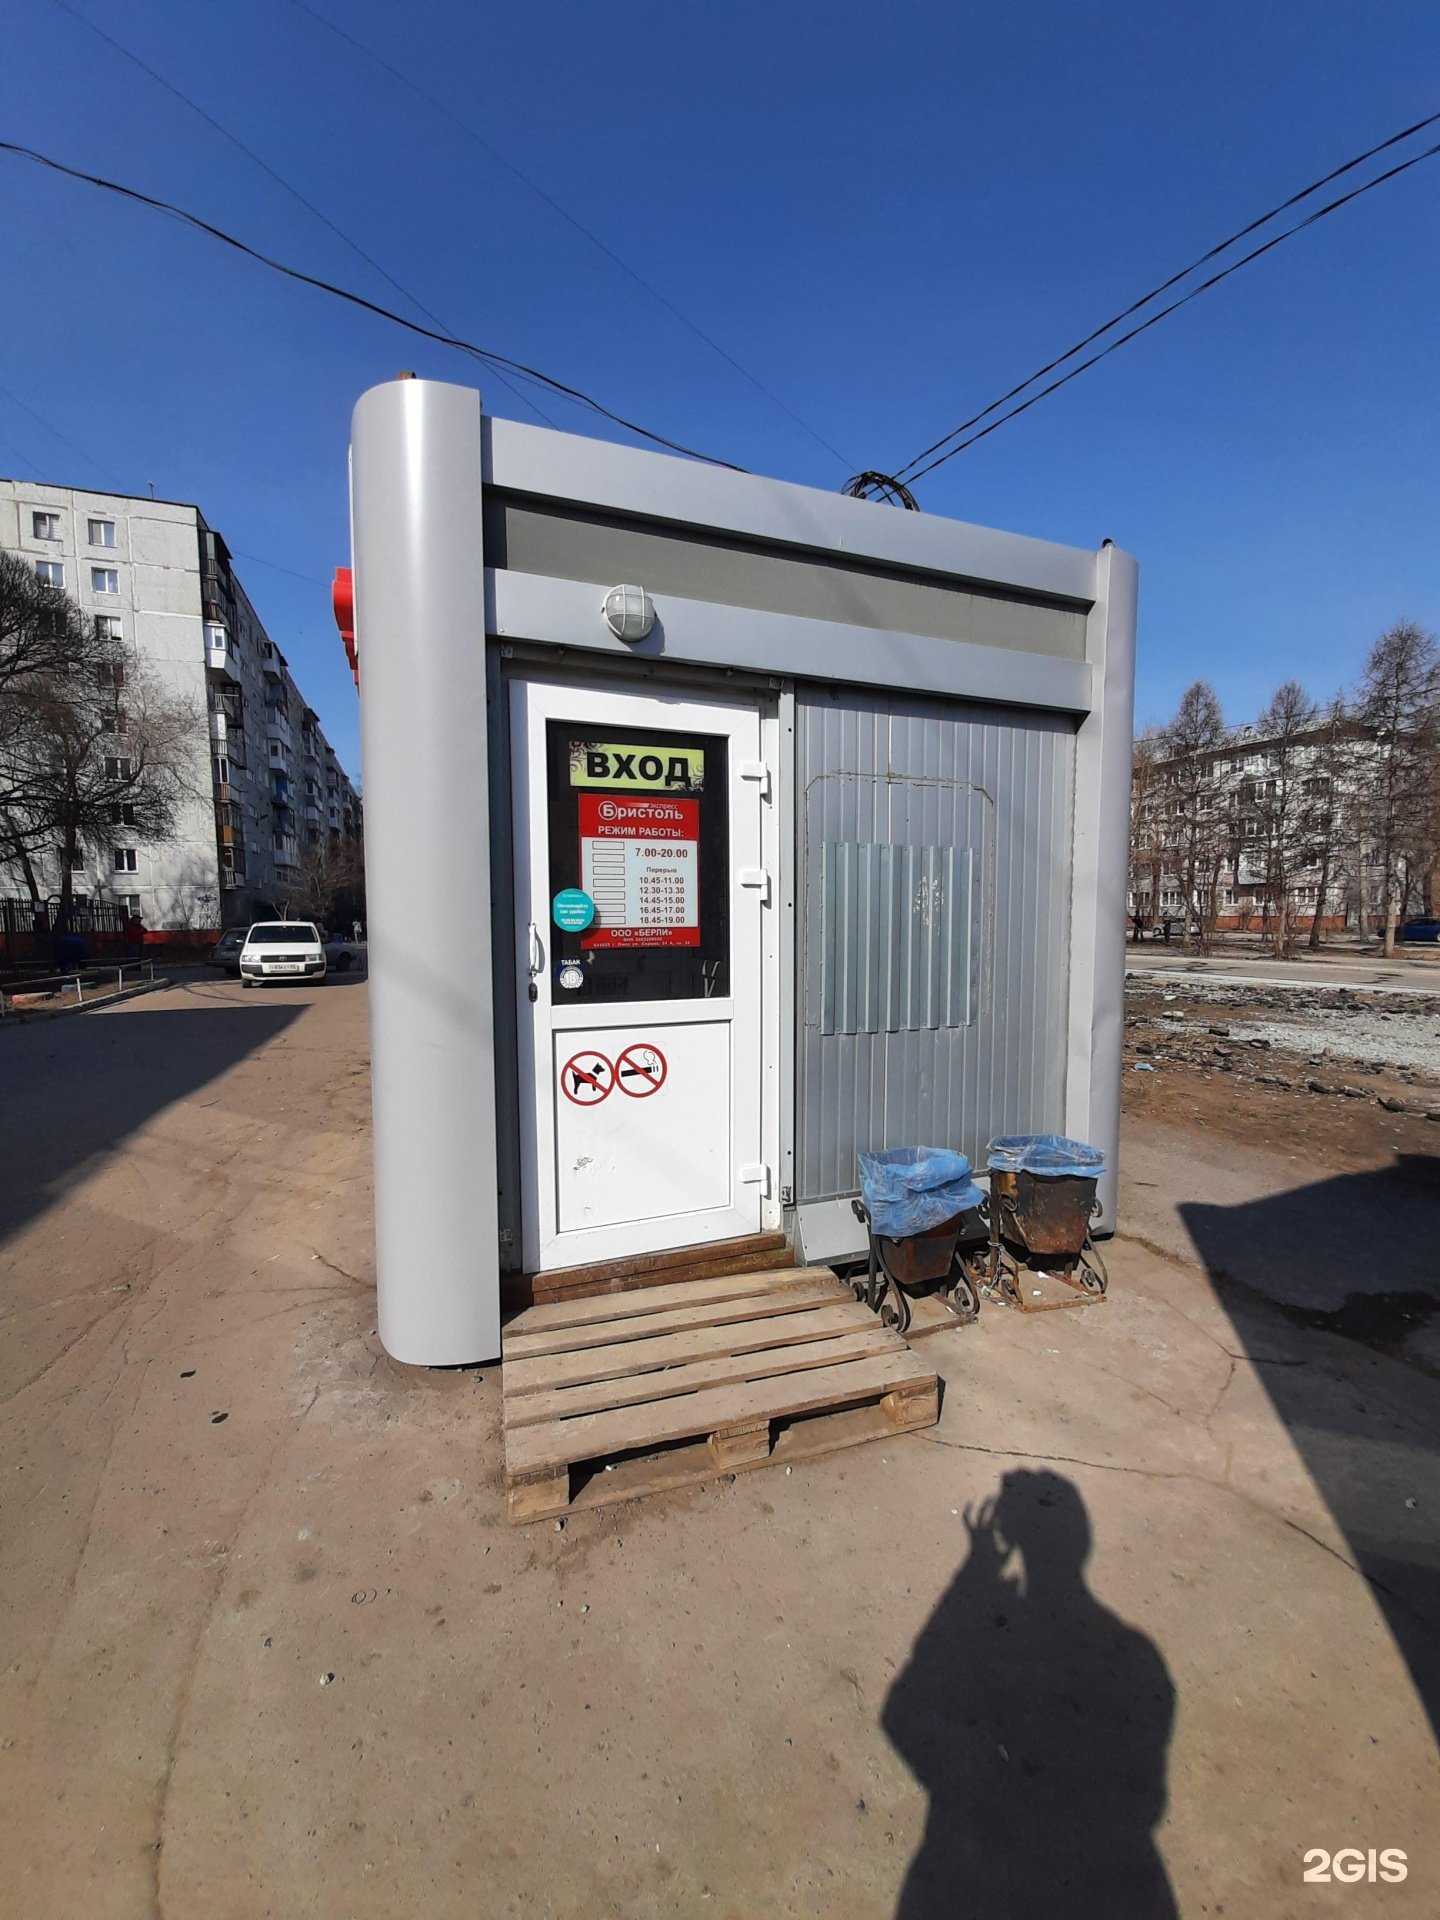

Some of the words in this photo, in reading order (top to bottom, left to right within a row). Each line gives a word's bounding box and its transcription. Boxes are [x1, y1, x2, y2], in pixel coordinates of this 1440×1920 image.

[586, 751, 692, 787] ВХОД
[598, 801, 684, 820] Бристоль
[598, 825, 637, 836] РЕЖИМ
[639, 826, 685, 837] РАБОТЫ:
[635, 847, 688, 859] 7.00-20.00
